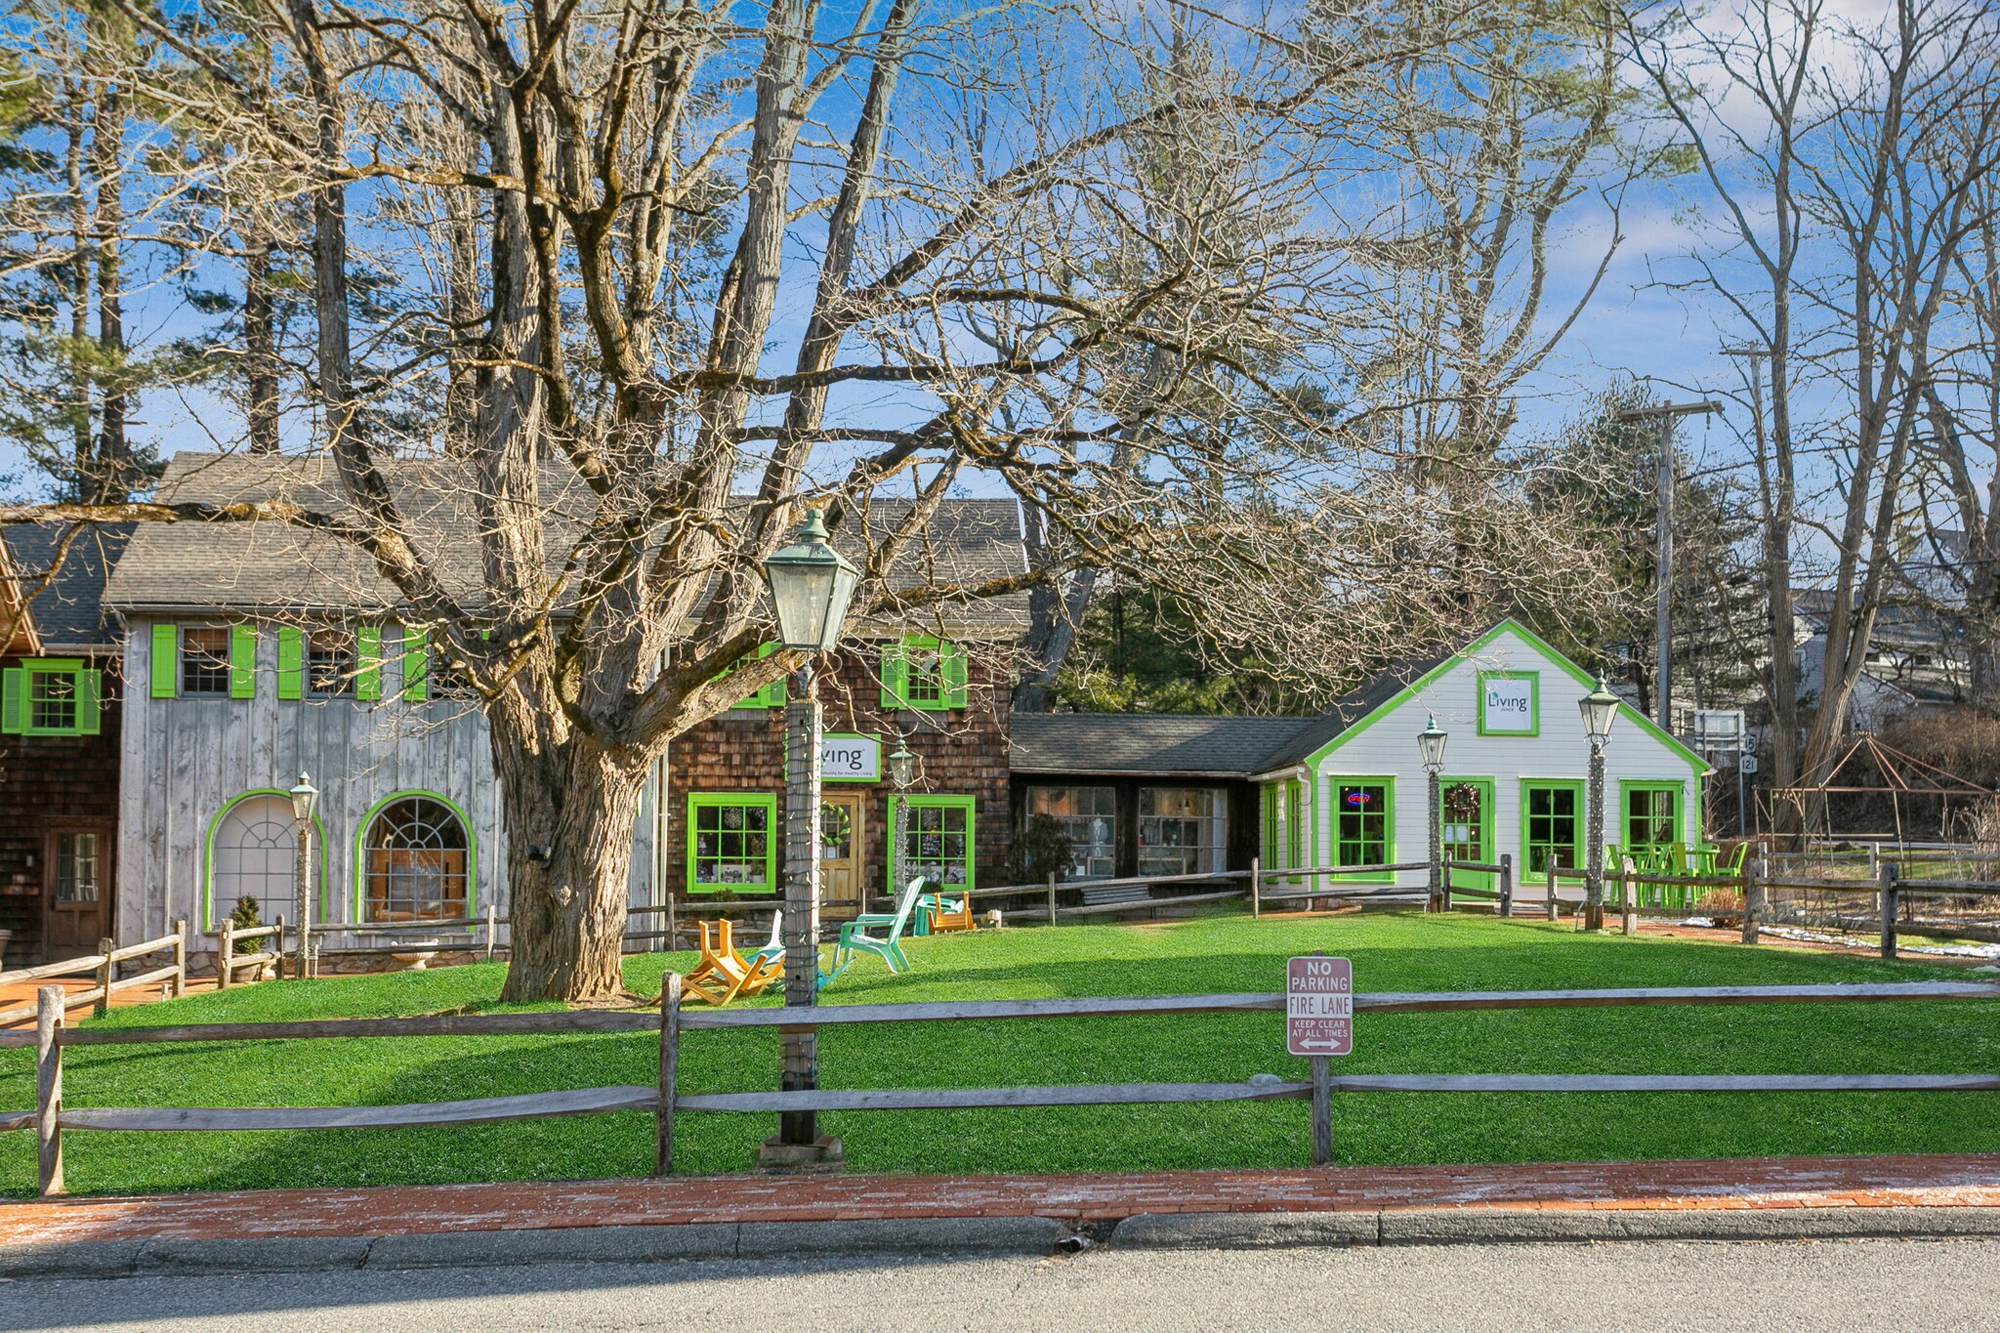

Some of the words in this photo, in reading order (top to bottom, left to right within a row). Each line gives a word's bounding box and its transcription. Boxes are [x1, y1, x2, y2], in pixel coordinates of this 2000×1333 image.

[1488, 693, 1527, 712] Living
[821, 749, 863, 770] ving
[1742, 760, 1754, 770] 121
[1307, 962, 1332, 975] NO
[1292, 977, 1348, 991] PARKING
[1290, 997, 1314, 1014] FIRE
[1322, 997, 1350, 1014] LANE
[1295, 1020, 1316, 1029] KEEP
[1318, 1020, 1345, 1029] CLEAR
[1292, 1029, 1303, 1037] AT
[1305, 1029, 1321, 1037] ALL
[1325, 1029, 1348, 1037] TIMES
